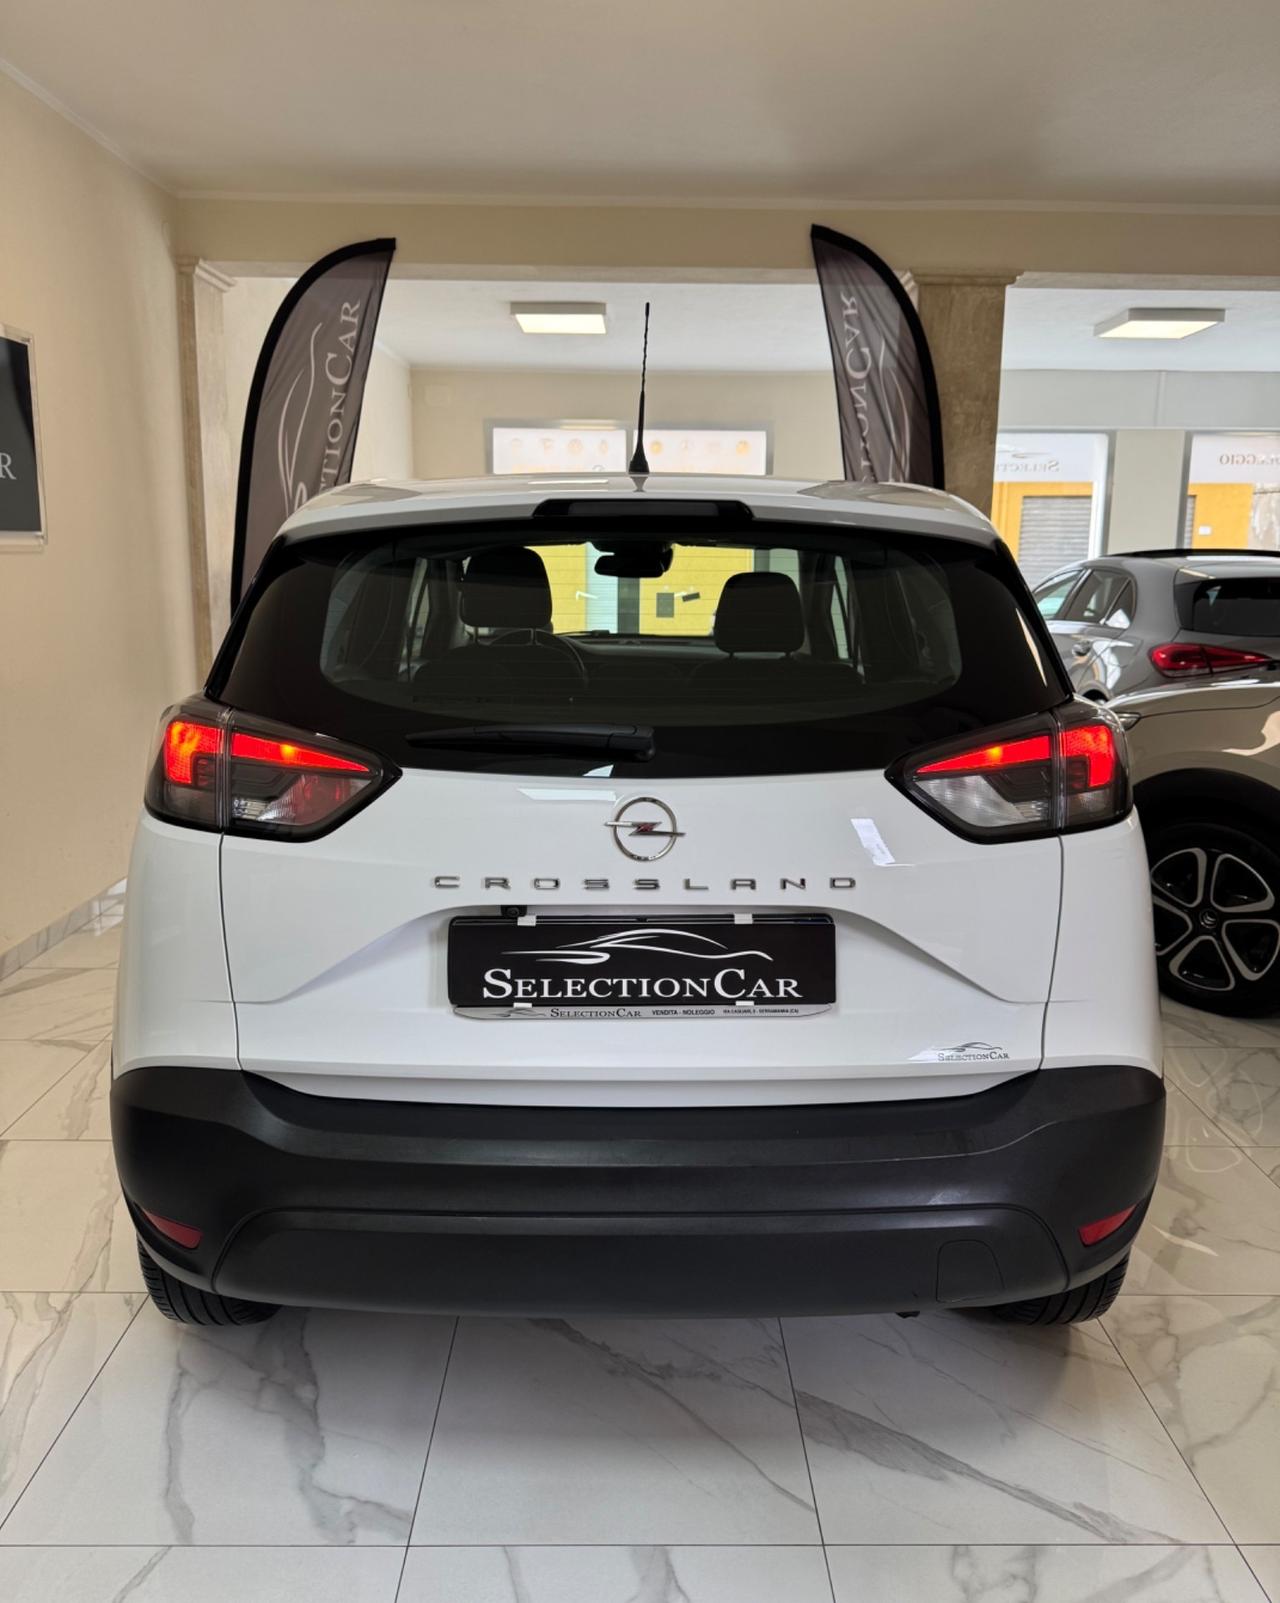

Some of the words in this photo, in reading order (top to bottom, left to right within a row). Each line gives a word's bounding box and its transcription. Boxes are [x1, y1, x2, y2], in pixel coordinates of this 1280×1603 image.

[319, 300, 361, 493] TIONCAR
[433, 876, 857, 891] CROSSLAND
[482, 968, 803, 999] SELECTIONCAR
[550, 1007, 642, 1018] SELECTIONCAR
[682, 1008, 715, 1016] NOLEGGIO
